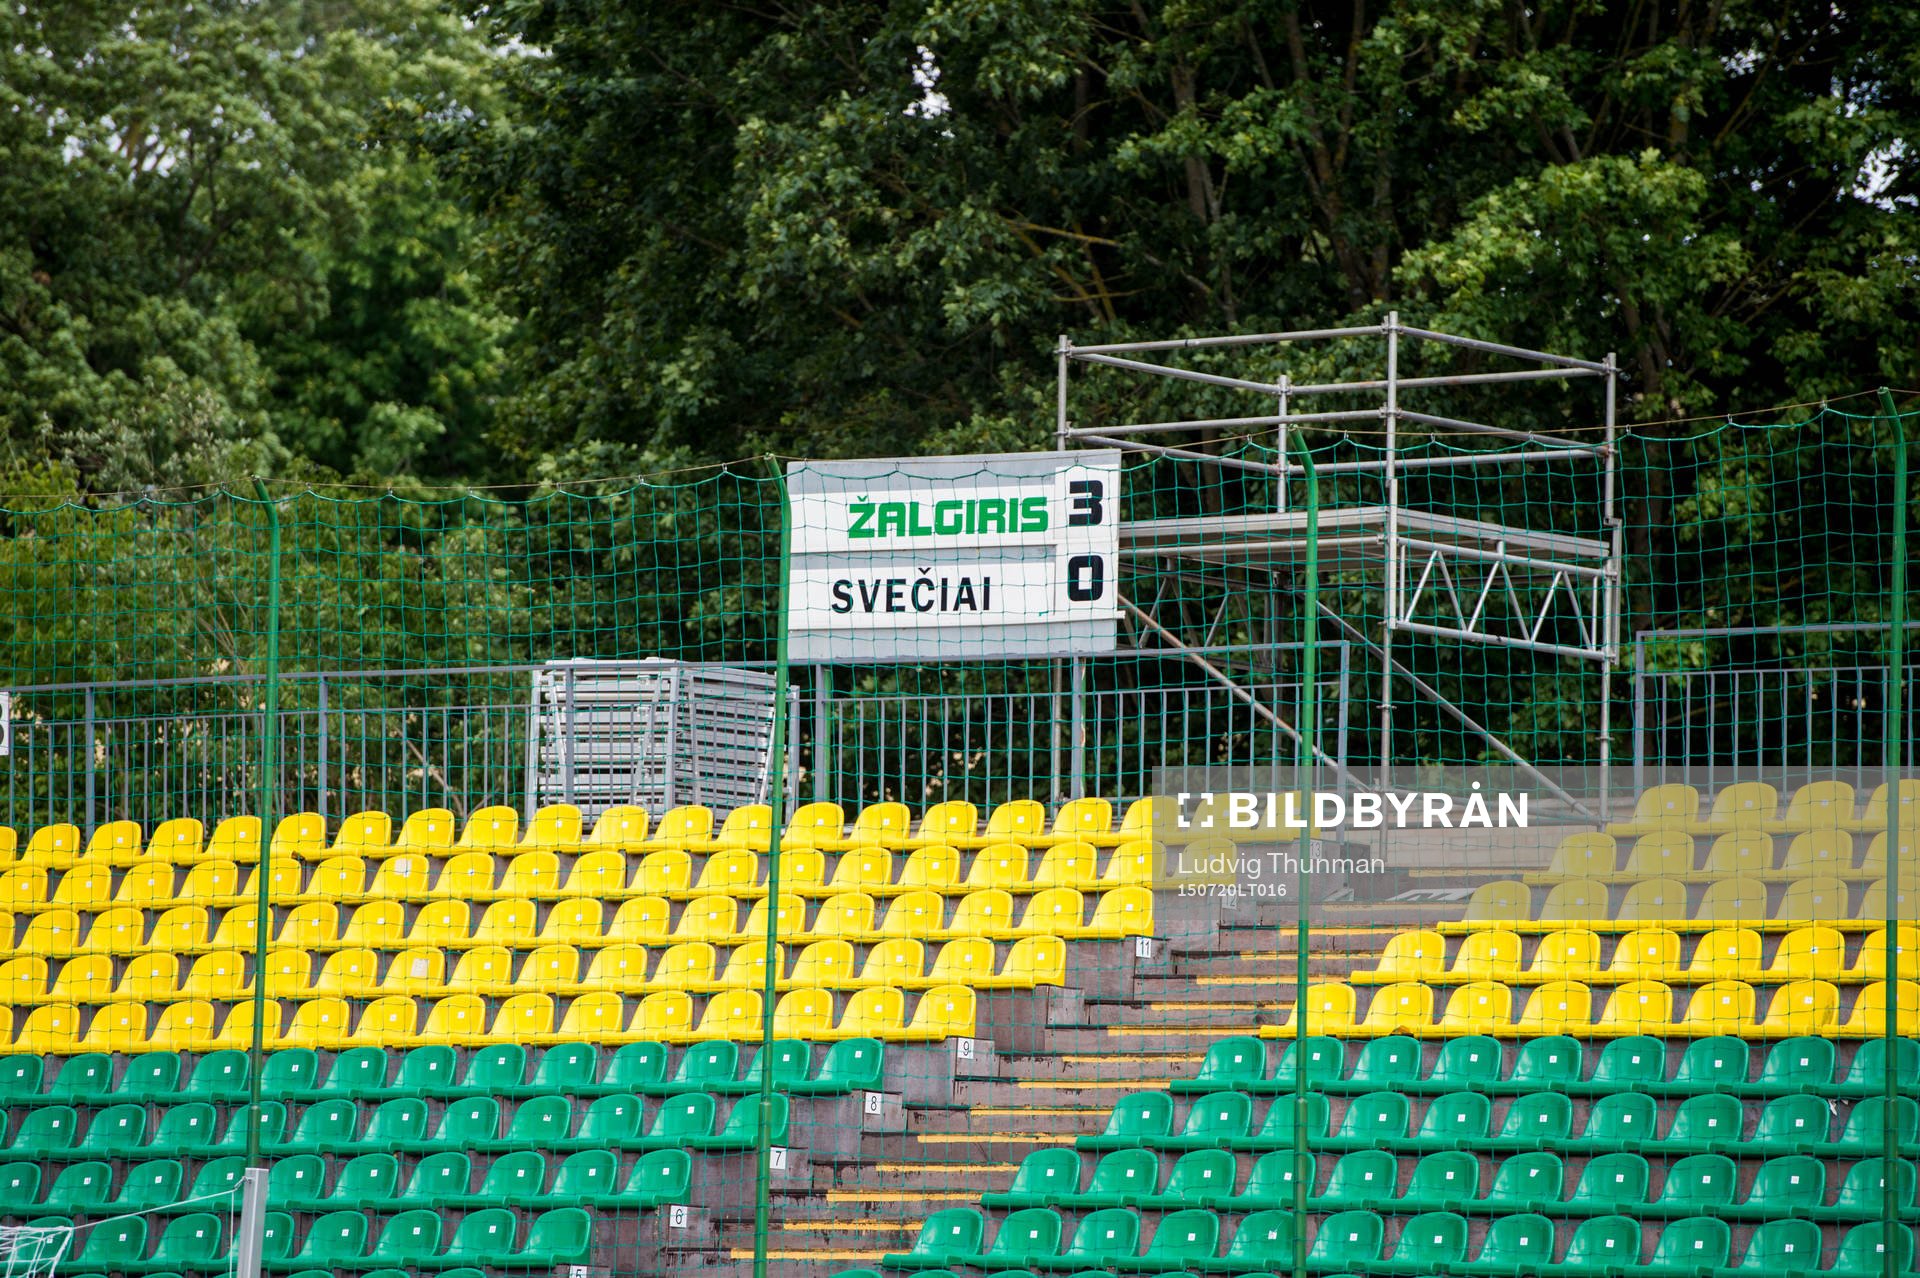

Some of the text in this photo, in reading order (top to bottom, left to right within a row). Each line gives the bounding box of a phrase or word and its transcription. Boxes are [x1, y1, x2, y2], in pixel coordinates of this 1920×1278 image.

[849, 480, 1103, 538] ŽALGIRIS 3
[831, 555, 1104, 613] SVEČIAI 0
[1140, 941, 1150, 956] 11
[963, 1040, 970, 1056] 9
[871, 1095, 878, 1111] 8
[775, 1150, 782, 1166] 7
[675, 1208, 683, 1225] 6
